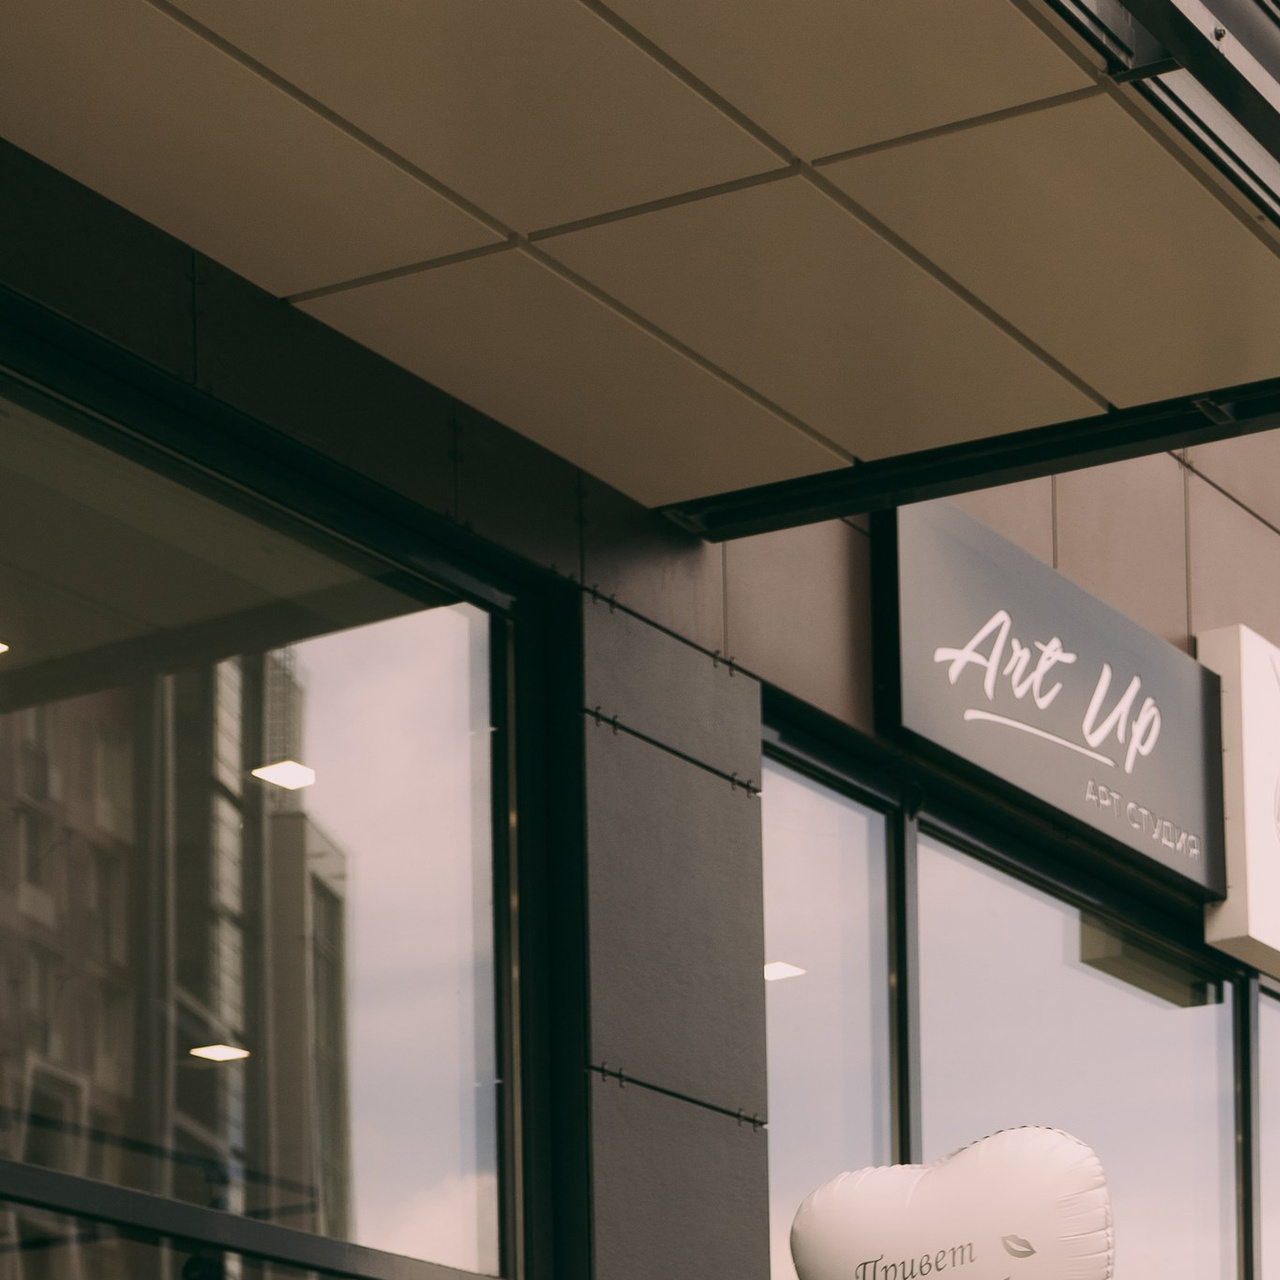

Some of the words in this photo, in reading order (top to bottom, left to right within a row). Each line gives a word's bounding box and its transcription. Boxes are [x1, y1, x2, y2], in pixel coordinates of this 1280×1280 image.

[933, 609, 1078, 710] Art
[1081, 662, 1163, 775] Up
[1085, 778, 1122, 818] АРТ
[1126, 801, 1201, 861] СТУДИЯ
